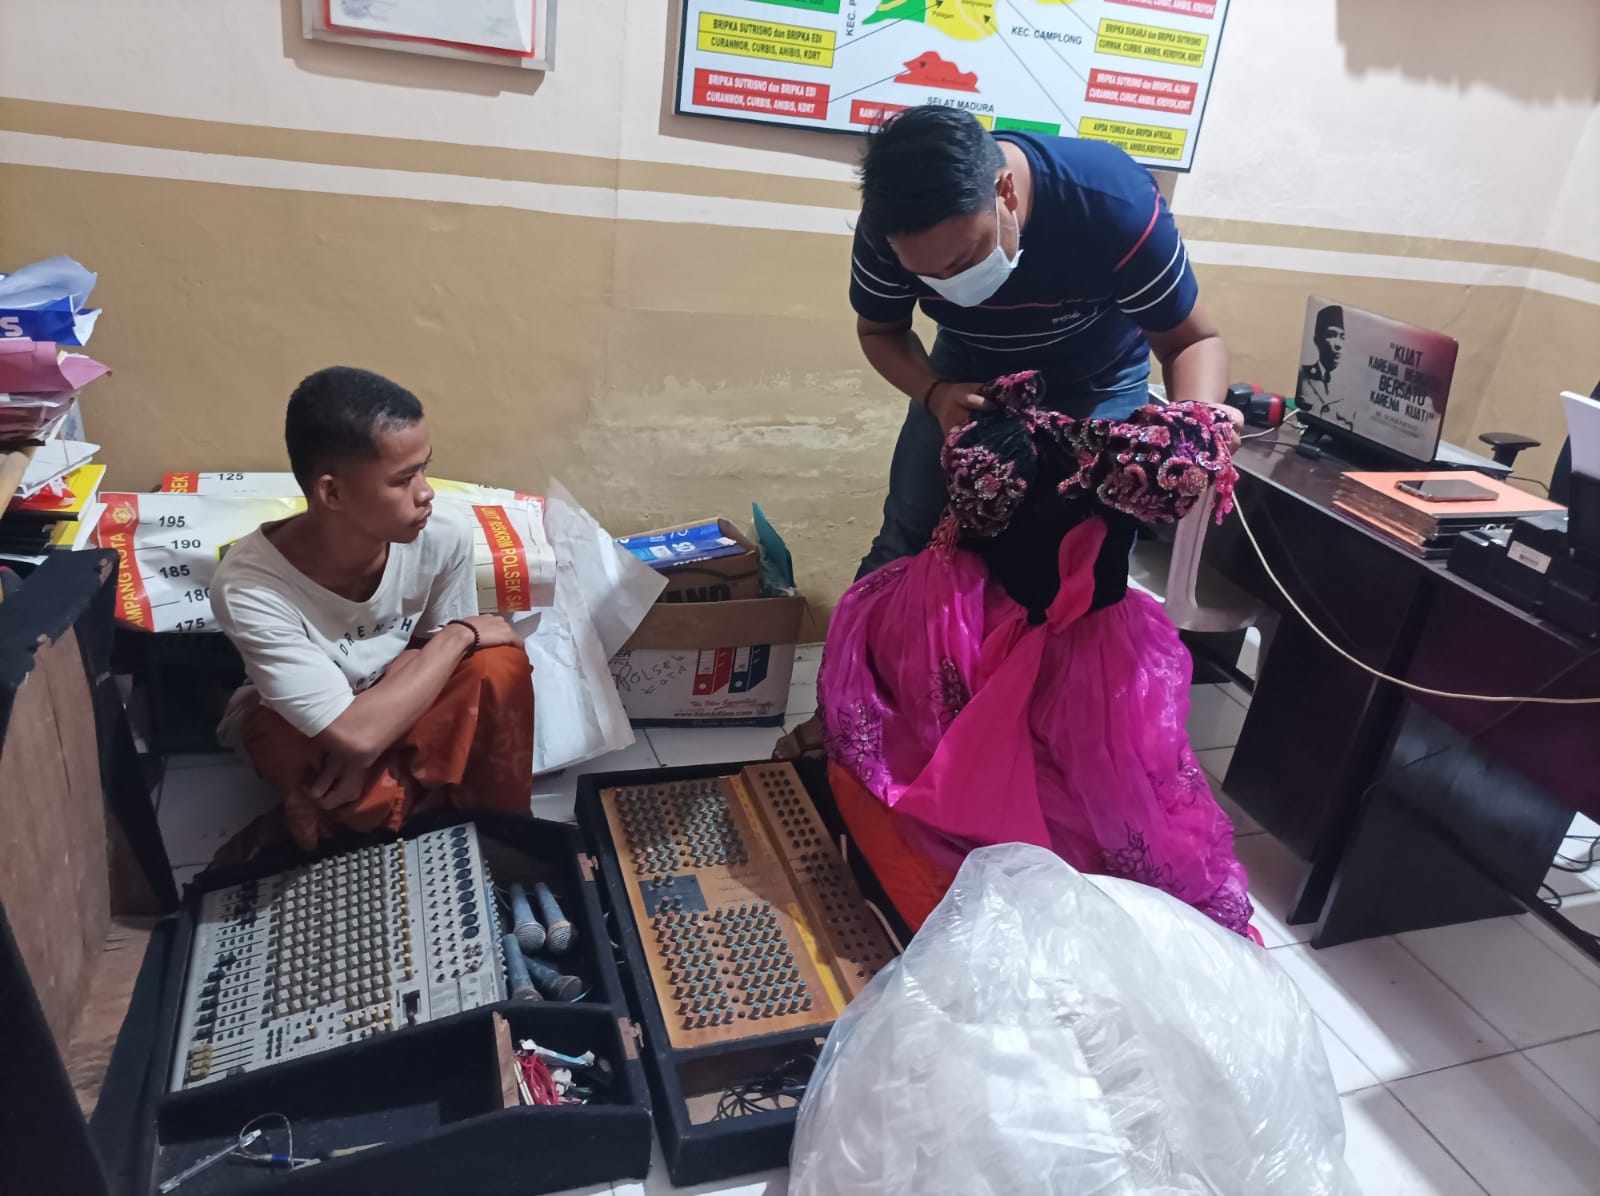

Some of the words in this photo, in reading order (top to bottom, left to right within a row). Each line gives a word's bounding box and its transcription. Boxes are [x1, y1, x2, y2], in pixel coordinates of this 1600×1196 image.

[713, 18, 738, 32] BRIPKA
[774, 28, 785, 38] dan
[786, 29, 810, 42] BRIPKA
[811, 33, 823, 44] EDI
[1034, 29, 1083, 45] CAMPLONG
[708, 74, 733, 87] BRIPKA
[780, 83, 804, 96] BRIPKA
[959, 101, 994, 113] MADURA
[1368, 355, 1399, 376] KARENA
[1378, 374, 1426, 406] BERSATU
[1369, 390, 1400, 412] KARENA
[218, 472, 244, 481] 125
[158, 515, 186, 528] 195
[171, 539, 202, 550] 190
[159, 564, 191, 579] 185
[501, 546, 521, 593] POLSEK
[175, 617, 206, 633] 175
